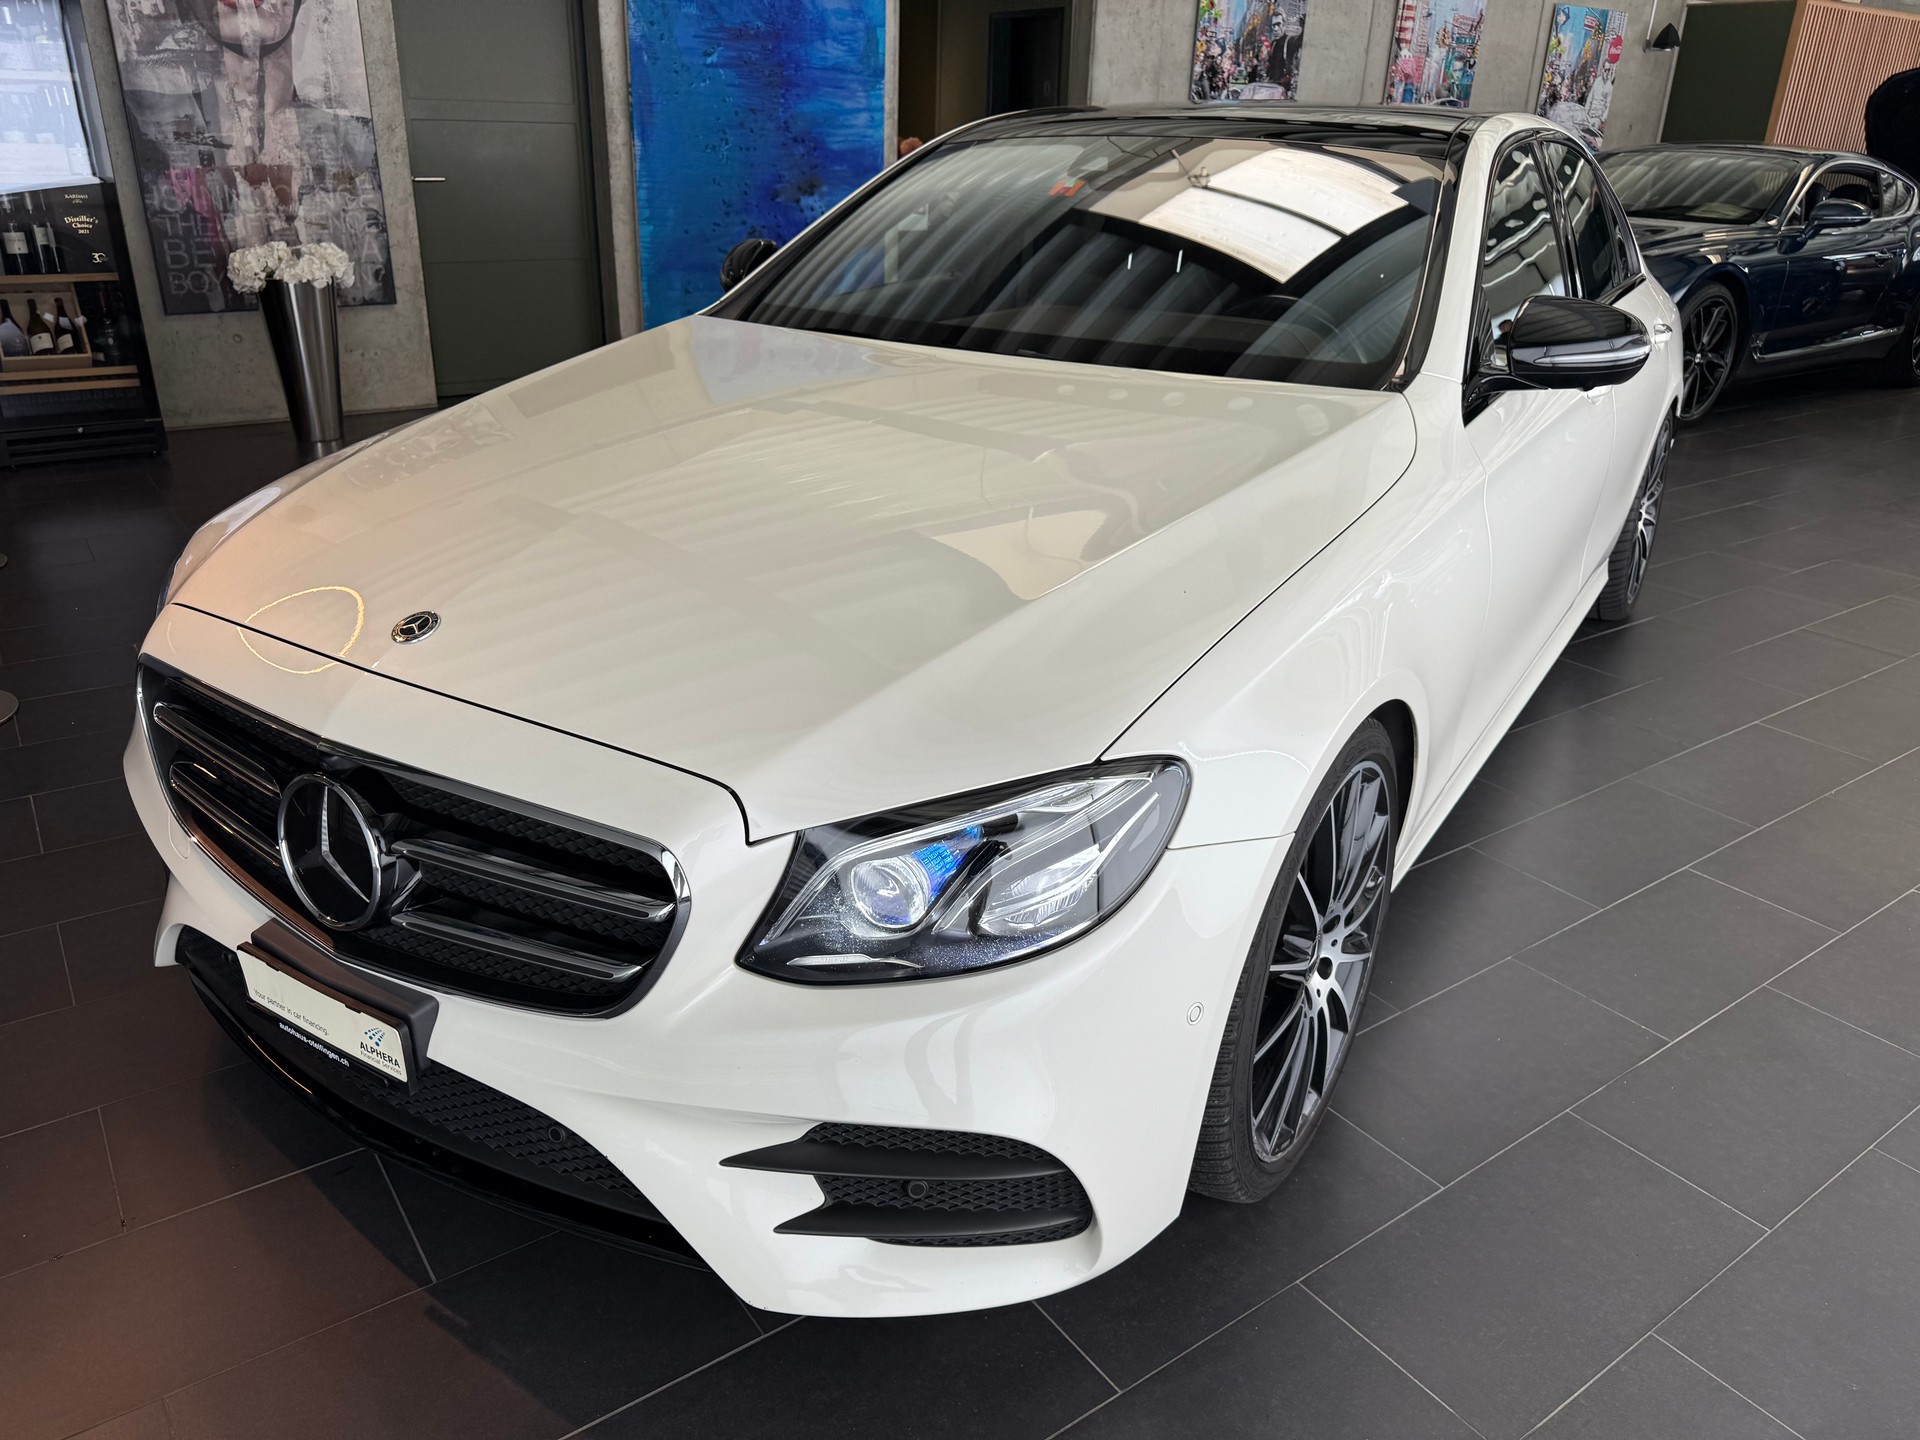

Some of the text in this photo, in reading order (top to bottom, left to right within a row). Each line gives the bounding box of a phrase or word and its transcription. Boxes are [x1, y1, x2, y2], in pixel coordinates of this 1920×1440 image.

[64, 215, 99, 224] Distiller's
[267, 995, 286, 1012] partner
[293, 1011, 302, 1021] car
[279, 1022, 350, 1067] autohaus-otelfingen.ch
[360, 1041, 401, 1068] ALPHERA
[360, 1050, 402, 1076] Financial Services
